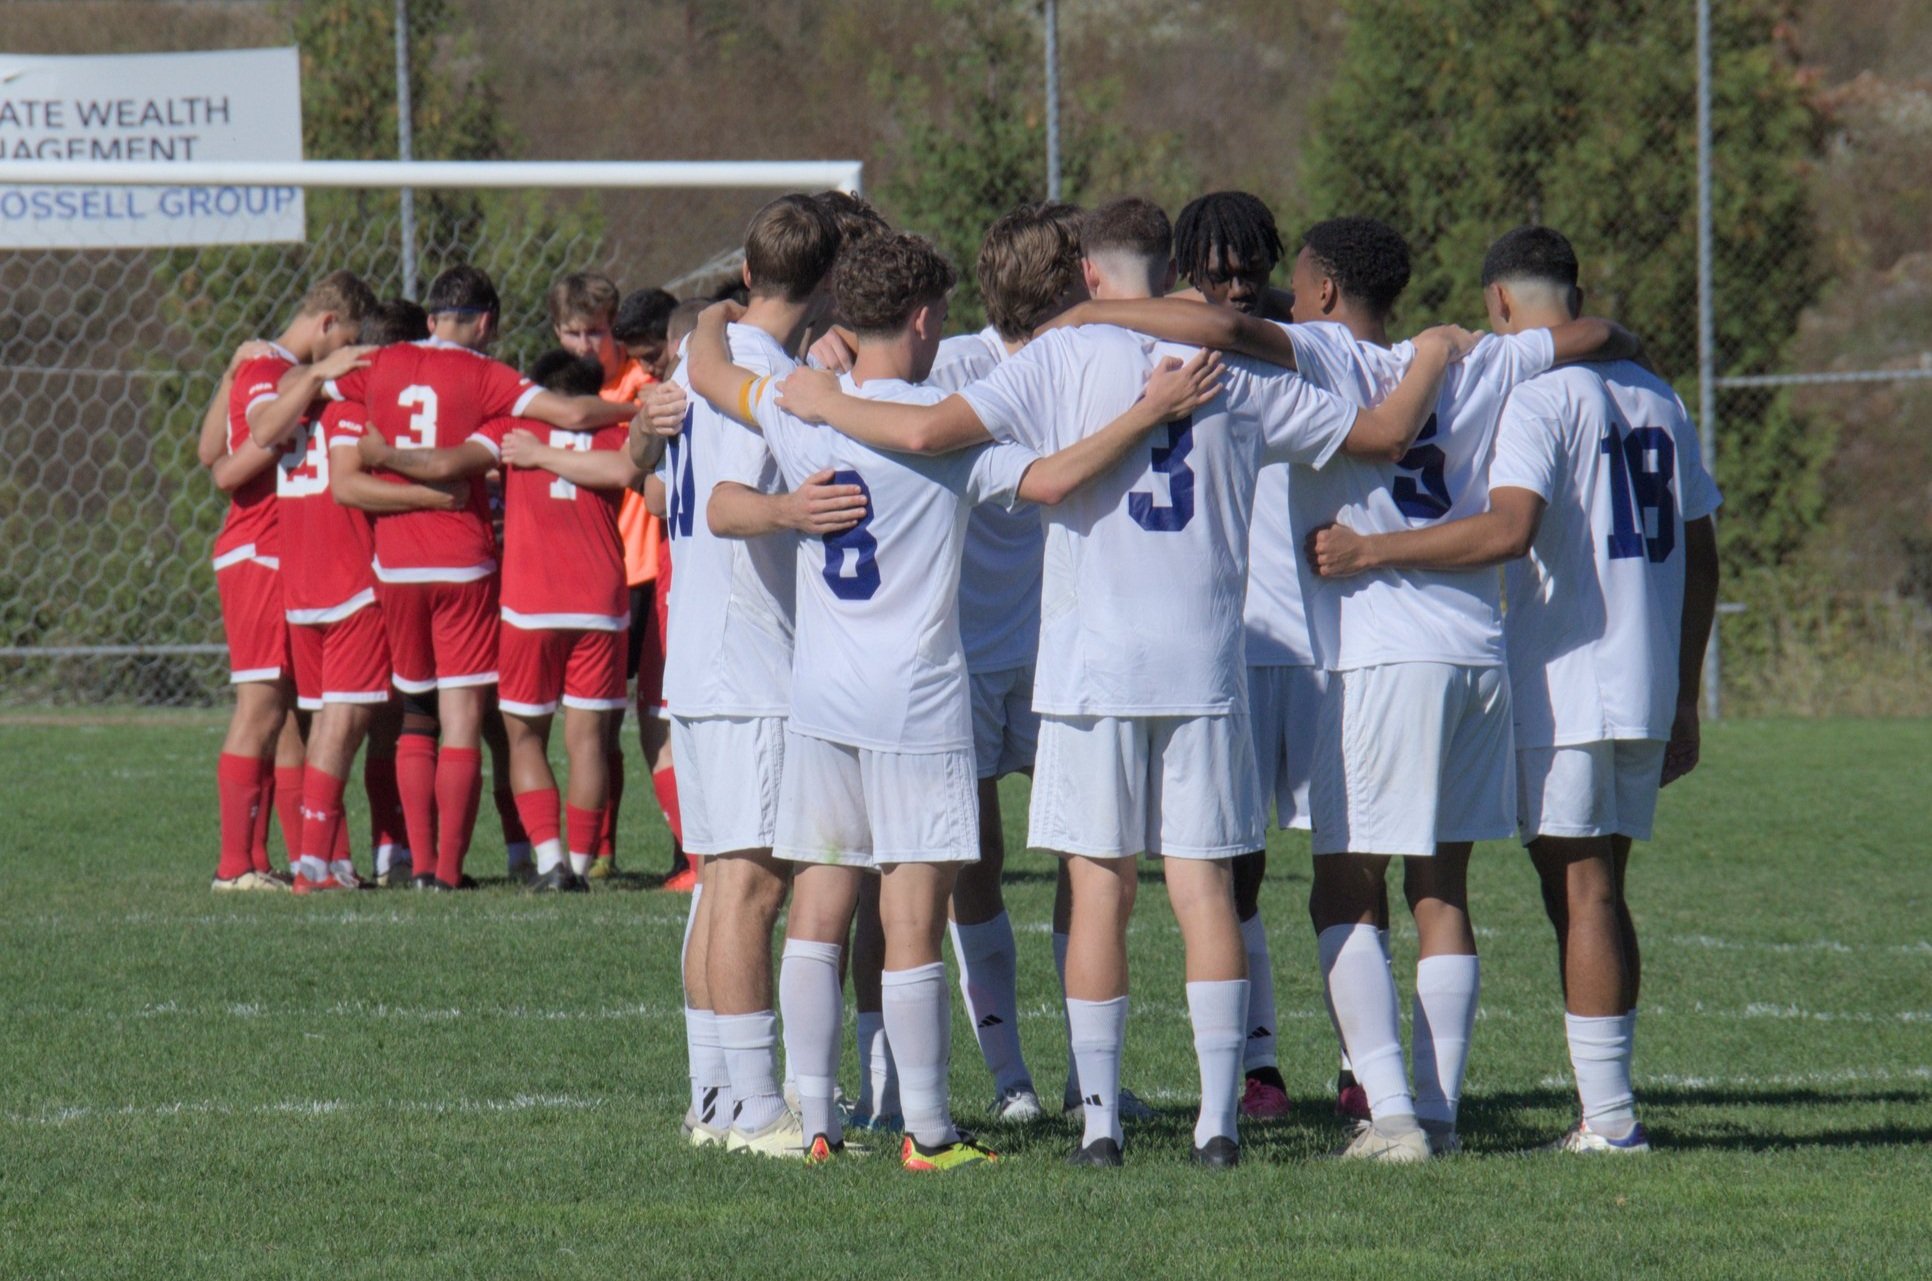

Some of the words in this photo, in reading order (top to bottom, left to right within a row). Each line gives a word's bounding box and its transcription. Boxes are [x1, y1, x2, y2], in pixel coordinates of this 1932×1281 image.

[0, 99, 63, 128] ATE
[76, 97, 230, 127] WEALTH
[0, 190, 146, 220] OSSELL
[159, 186, 295, 217] GROUP
[395, 384, 438, 449] 3
[1129, 415, 1194, 531] 3
[1601, 422, 1674, 563] 18
[822, 470, 881, 600] 8
